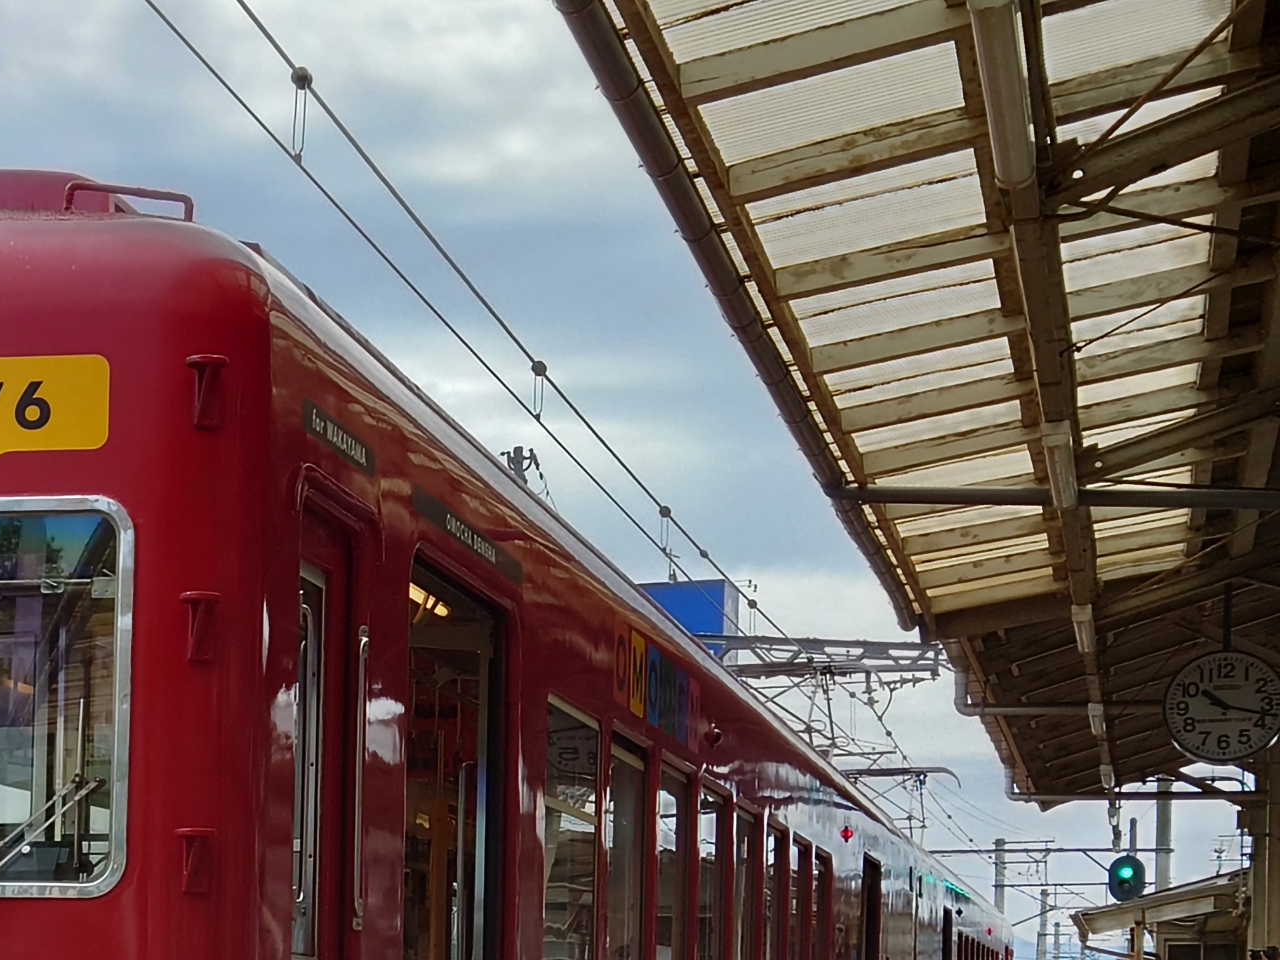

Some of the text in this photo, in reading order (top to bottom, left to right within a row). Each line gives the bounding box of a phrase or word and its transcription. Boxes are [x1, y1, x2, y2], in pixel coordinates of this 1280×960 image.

[311, 408, 367, 467] for WAKAYAMA
[445, 513, 496, 564] OMOCHA DENSHA
[1200, 667, 1213, 683] 11
[1218, 662, 1236, 679] 12
[1245, 665, 1250, 682] 1
[1181, 681, 1200, 698] 10
[1254, 677, 1269, 694] 2
[1176, 700, 1189, 716] 9
[1261, 696, 1274, 713] 3
[1182, 716, 1196, 733] 8
[1253, 713, 1267, 730] 4
[1198, 731, 1212, 746] 7
[1217, 734, 1231, 750] 6
[1237, 728, 1251, 745] 5
